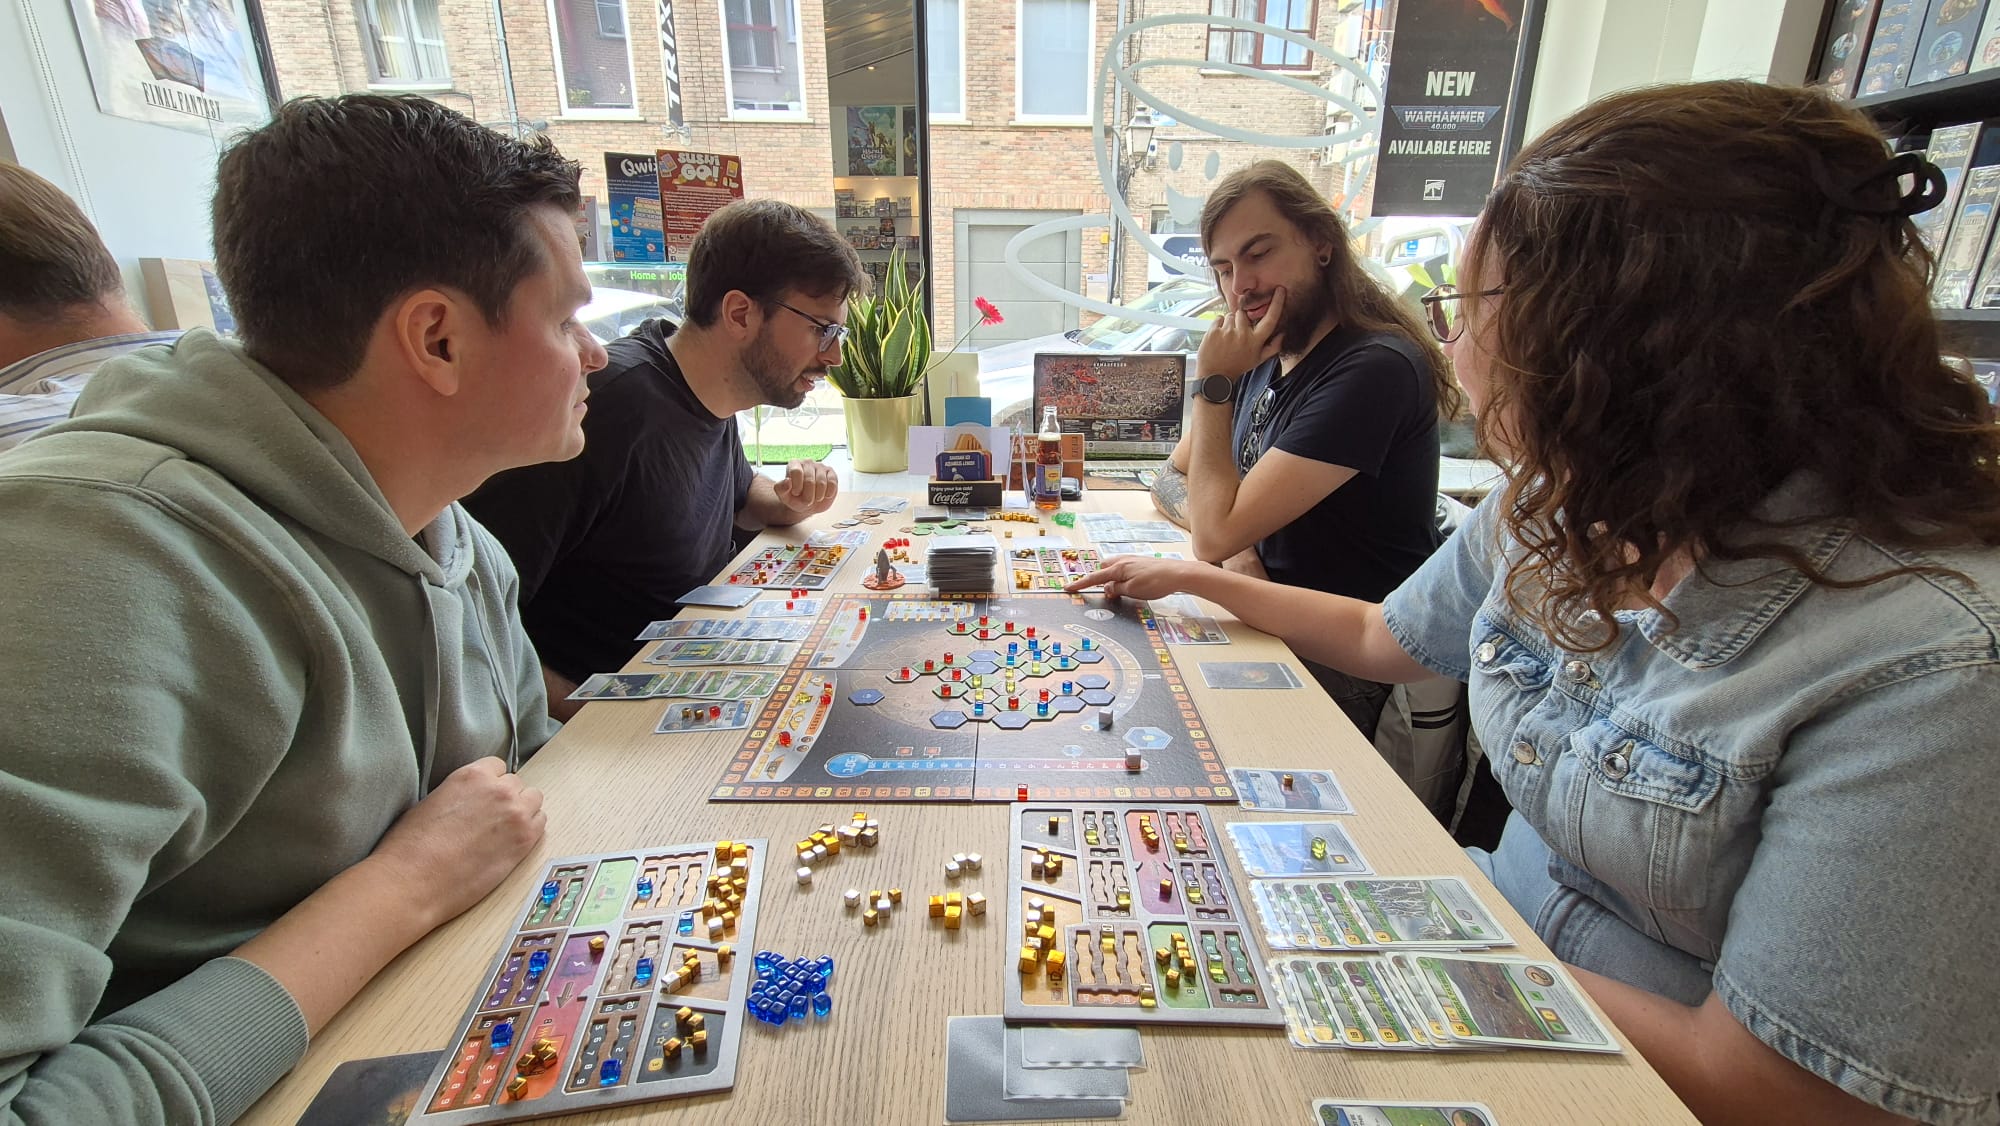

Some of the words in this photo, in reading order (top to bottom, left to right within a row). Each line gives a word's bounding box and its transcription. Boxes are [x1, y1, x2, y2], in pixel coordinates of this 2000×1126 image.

[1425, 71, 1476, 97] NEW
[141, 81, 177, 109] FINAL
[177, 90, 222, 121] FANTASY
[1404, 111, 1485, 123] WARHAMMER
[1388, 140, 1456, 155] AVAILABLE
[1458, 140, 1492, 155] HERE
[681, 164, 719, 182] GO!
[630, 271, 657, 281] Home
